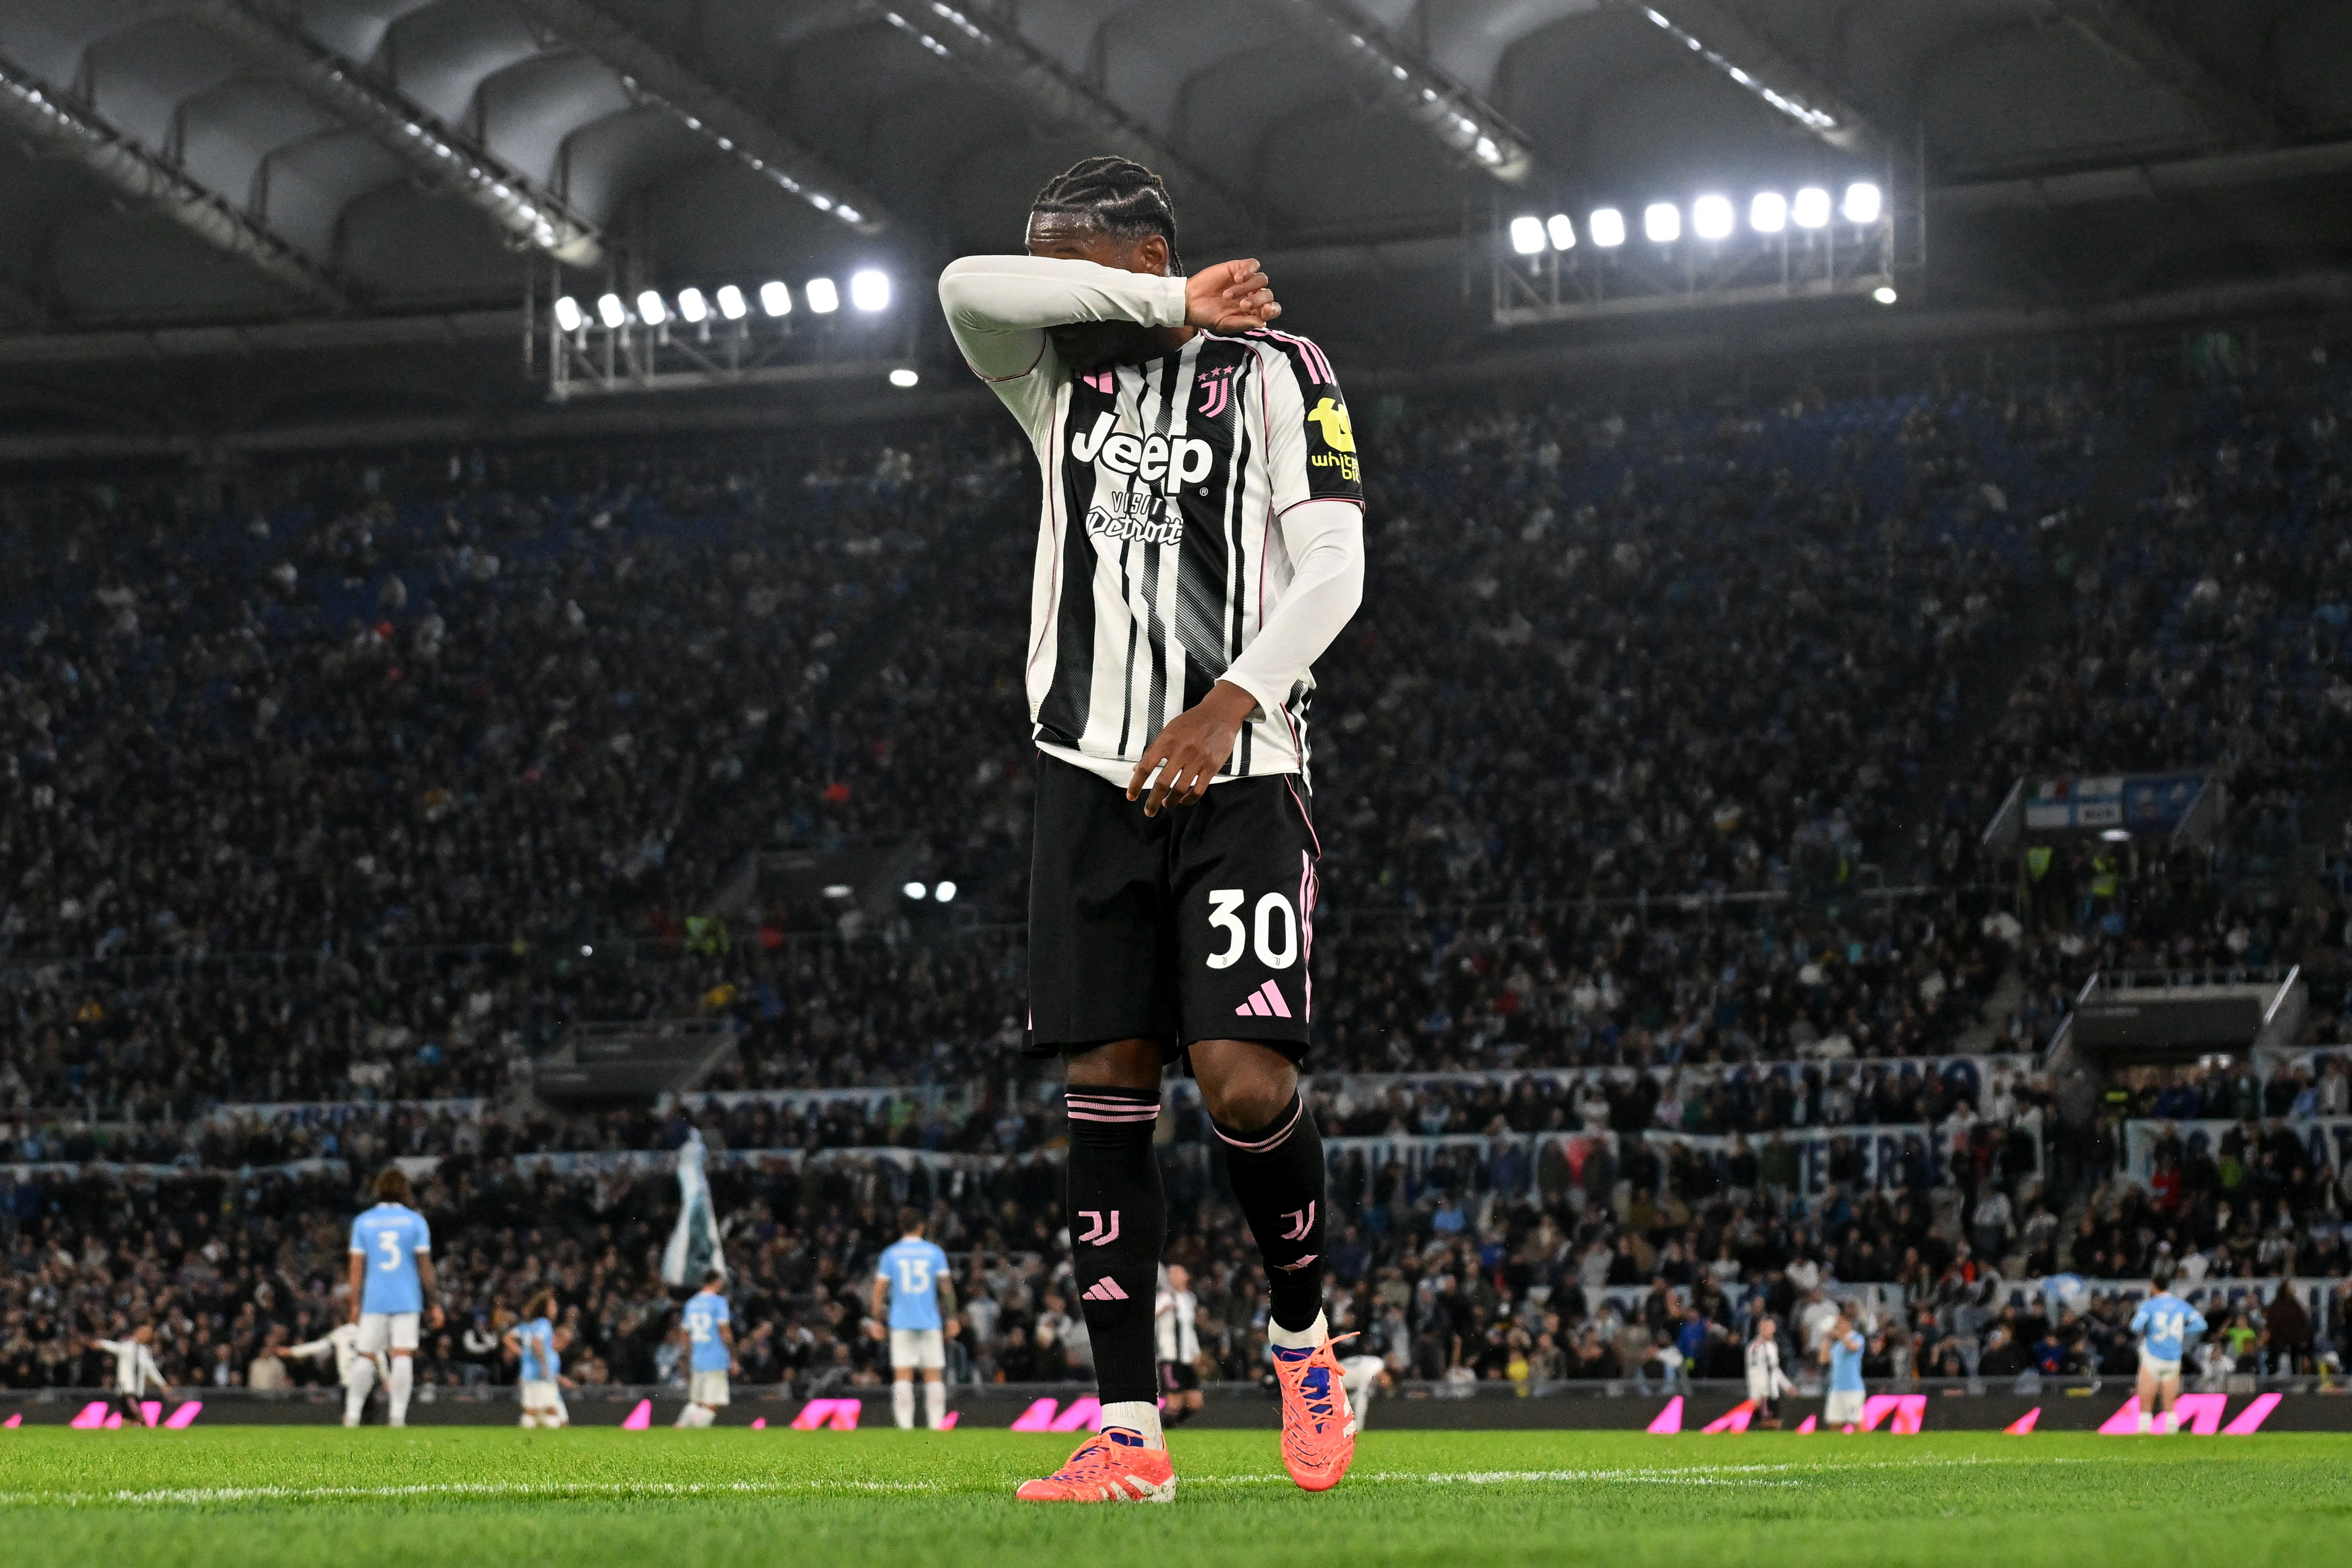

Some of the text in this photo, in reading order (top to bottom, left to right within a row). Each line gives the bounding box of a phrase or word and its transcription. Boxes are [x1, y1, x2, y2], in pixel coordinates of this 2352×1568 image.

[1072, 411, 1213, 494] Jeep
[1341, 464, 1360, 484] bit
[1111, 491, 1164, 515] VISIT
[1087, 505, 1184, 546] Detroit
[1206, 889, 1298, 969] 30
[378, 1230, 401, 1271] 3
[898, 1259, 930, 1294] 13
[2154, 1311, 2183, 1343] 34
